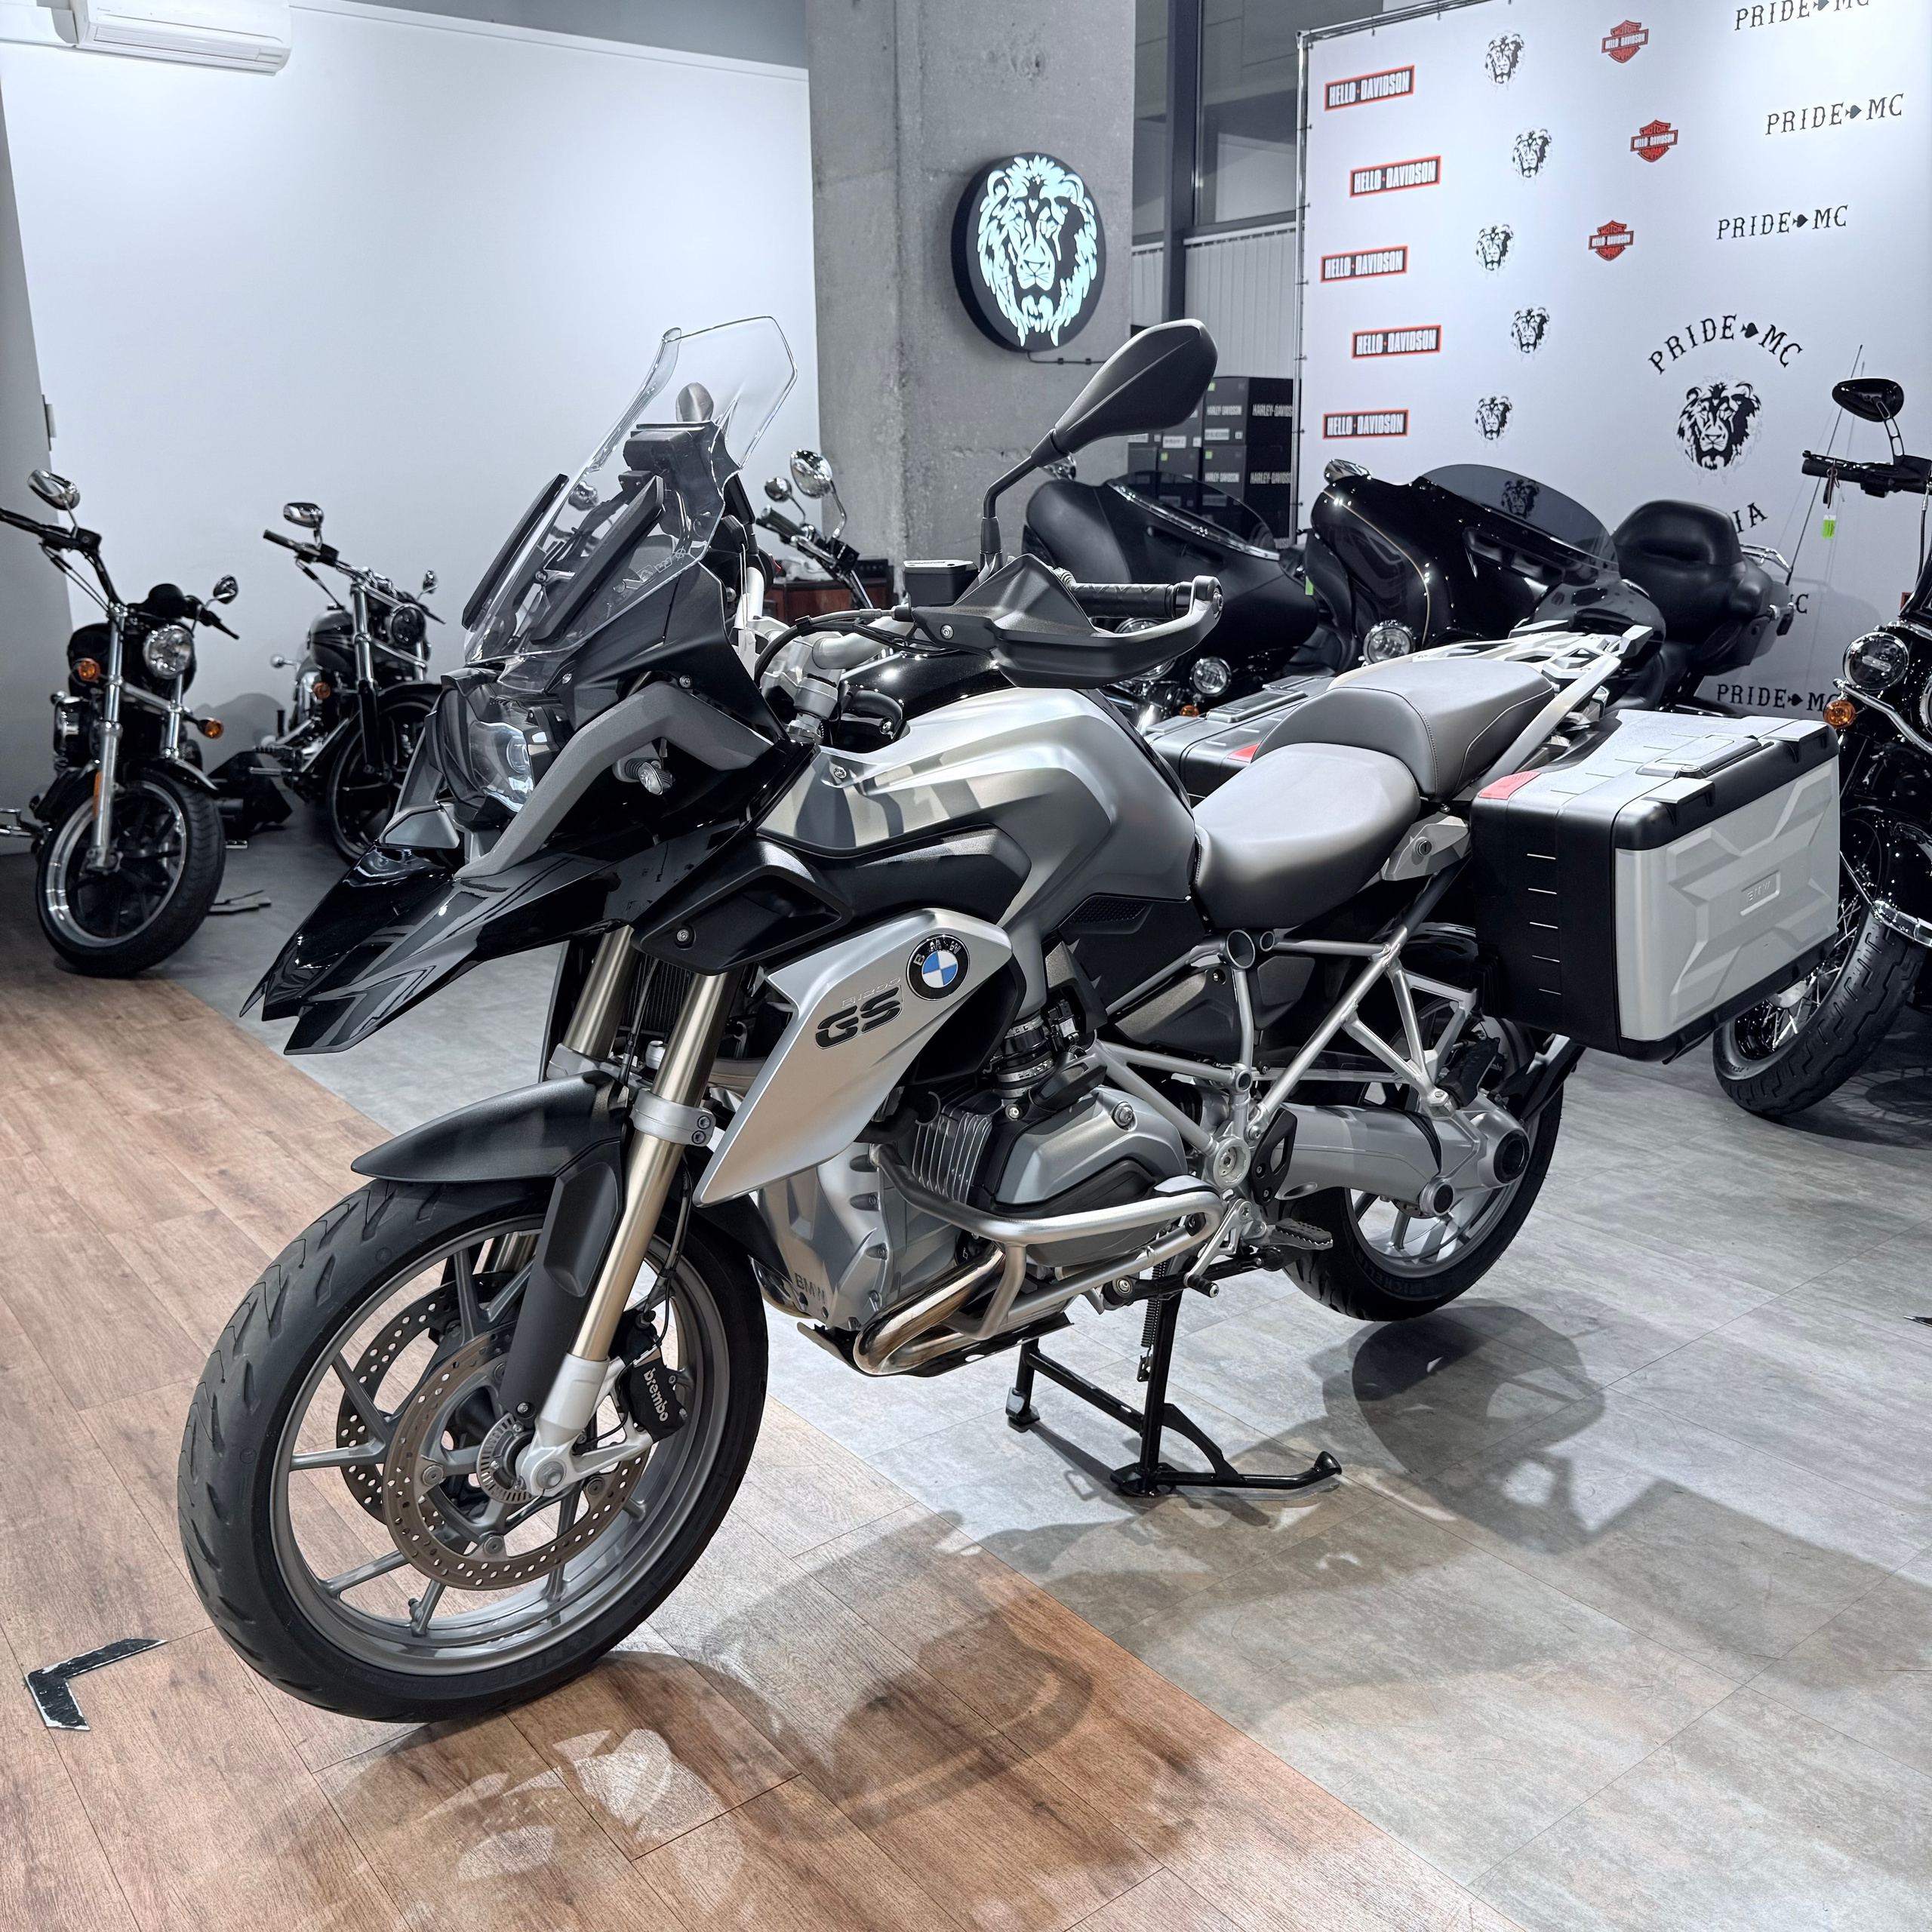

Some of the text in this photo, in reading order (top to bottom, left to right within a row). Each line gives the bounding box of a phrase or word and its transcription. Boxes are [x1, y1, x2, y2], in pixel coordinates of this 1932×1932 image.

[1734, 0, 1810, 31] PRIDE
[1329, 70, 1411, 106] HELLO DAVIDSON
[1765, 93, 1904, 135] PRIDE MC
[1354, 160, 1436, 194] HELLO DAVIDSON
[1716, 205, 1848, 240] PRIDE MC
[1324, 250, 1404, 278] HELLO DAVIDSON
[1356, 328, 1437, 355] HELLO DAVIDSON
[1647, 313, 1803, 375] PRIDE MC
[1252, 403, 1293, 417] HARLEY-DAVIDS
[1327, 413, 1404, 435] HELLO DAVIDSON
[1250, 472, 1292, 485] HARLEY-DAVIDSO
[1717, 683, 1787, 709] PRIDE
[912, 939, 962, 966] BMW
[815, 986, 902, 1048] GS
[644, 1367, 669, 1422] brembo
